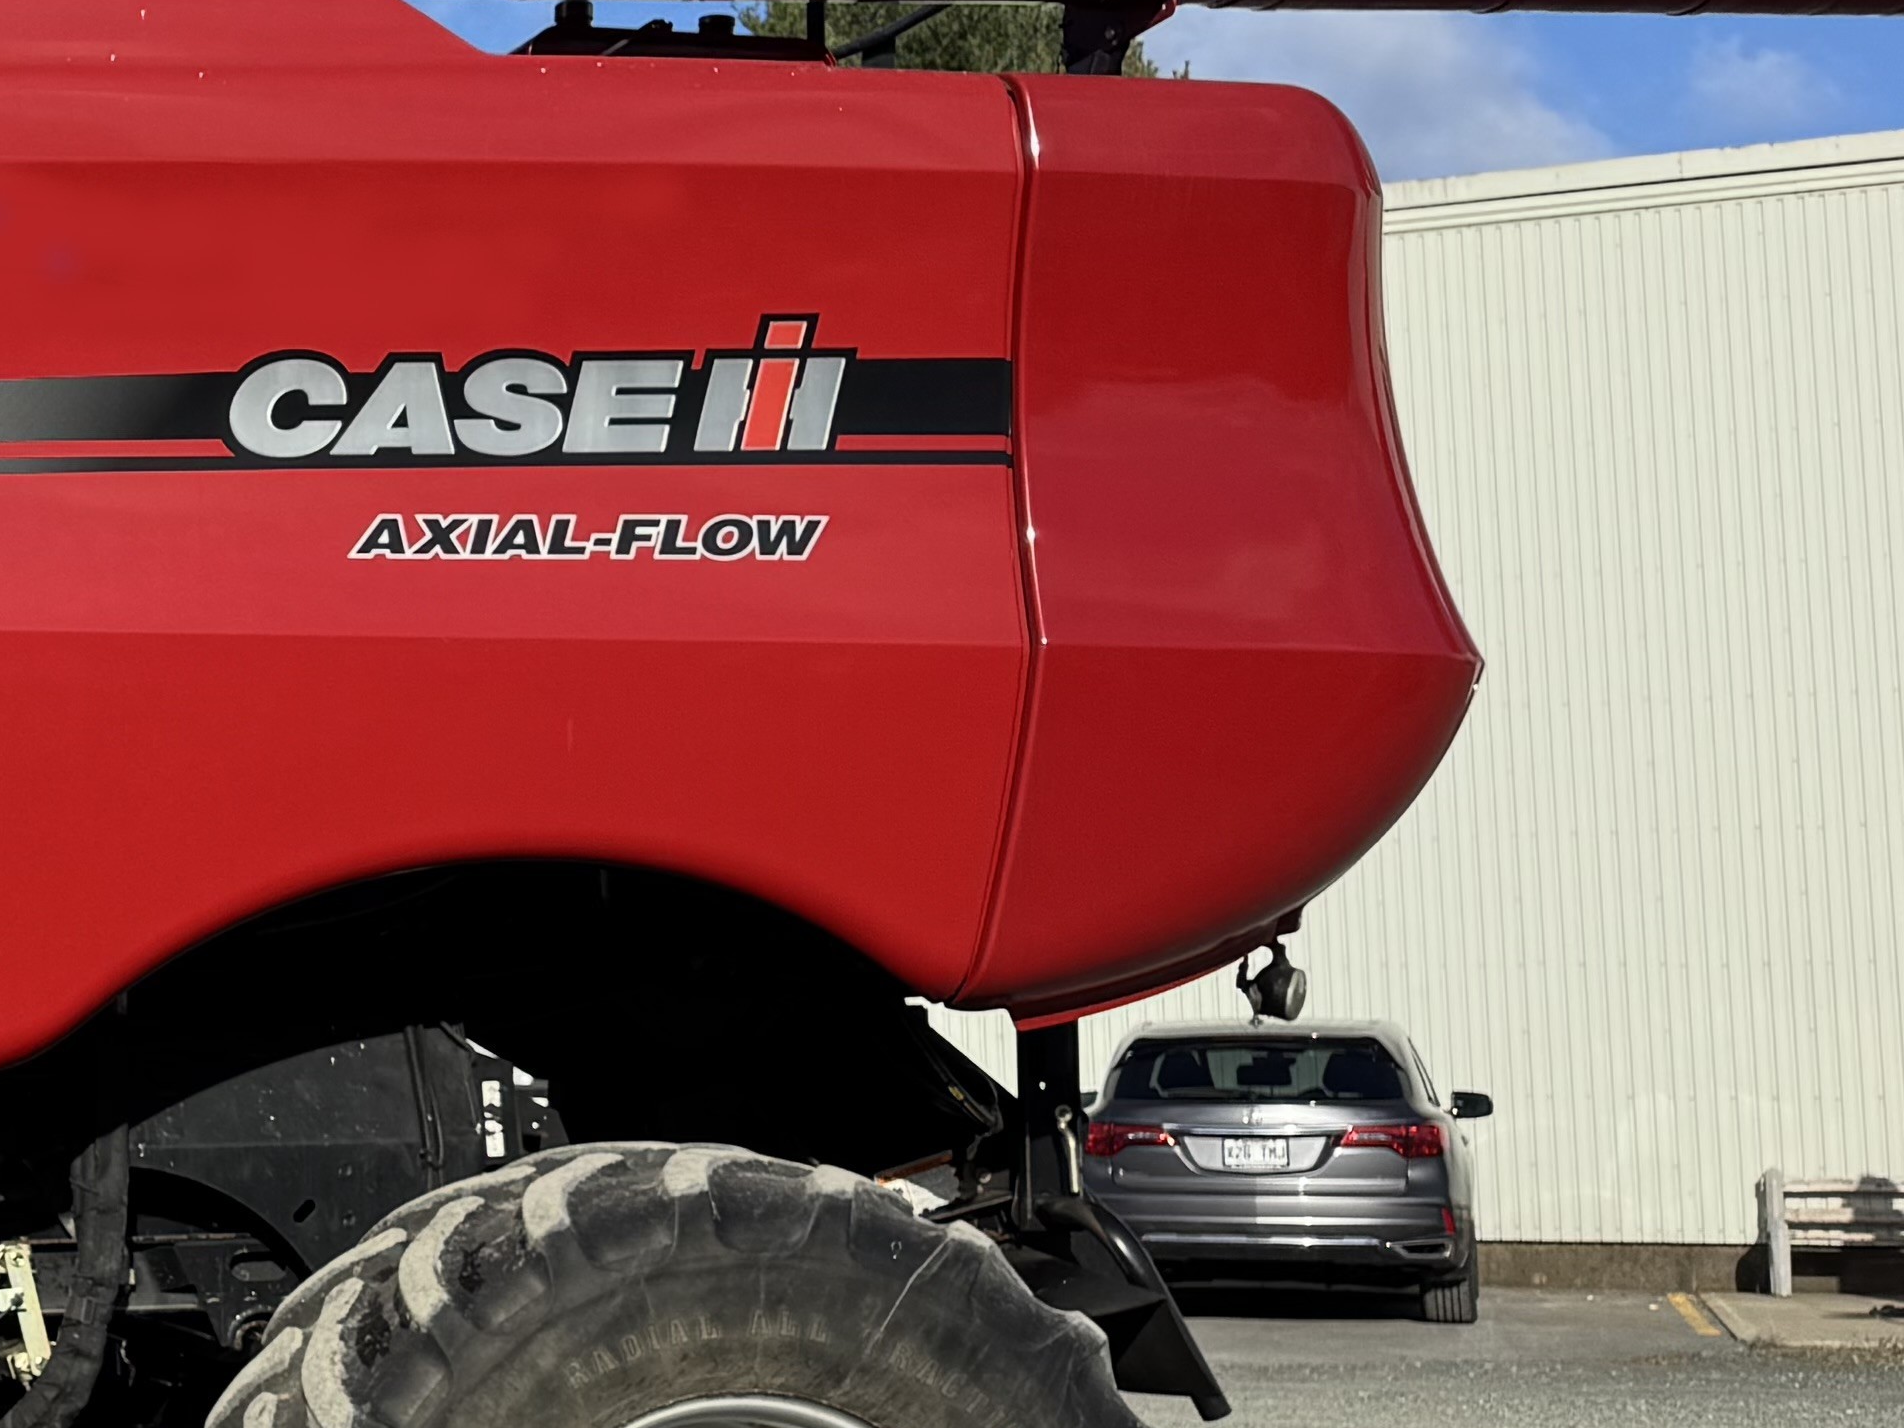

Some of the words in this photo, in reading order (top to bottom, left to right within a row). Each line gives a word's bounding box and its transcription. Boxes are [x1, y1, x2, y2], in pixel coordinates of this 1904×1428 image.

[228, 357, 684, 458] CASE
[349, 514, 829, 561] AXIAL-FLOW
[566, 1314, 723, 1390] RADIAL
[747, 1308, 831, 1343] ALL
